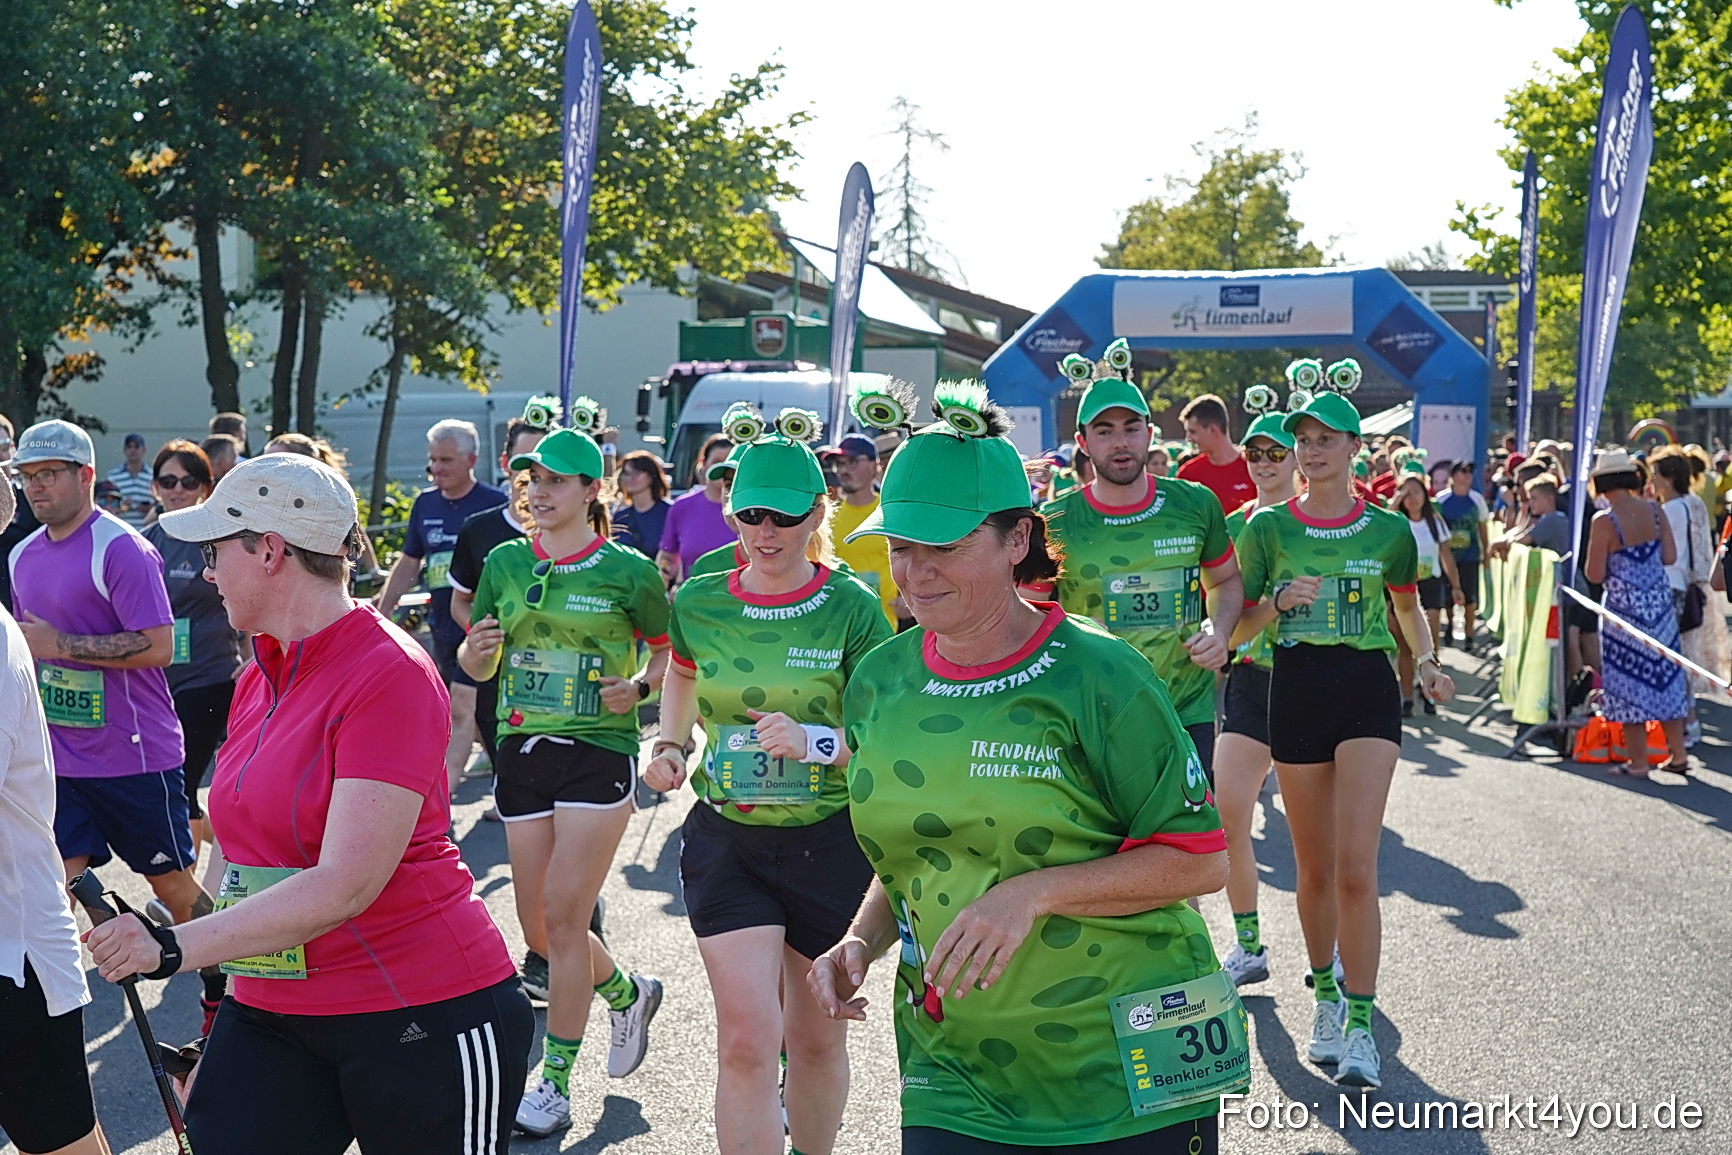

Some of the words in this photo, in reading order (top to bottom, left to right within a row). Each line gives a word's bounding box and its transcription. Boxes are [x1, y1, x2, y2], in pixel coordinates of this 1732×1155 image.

[29, 440, 57, 448] GOING
[1132, 592, 1160, 613] 33
[1327, 601, 1336, 629] 2022
[524, 670, 550, 692] 37
[563, 677, 574, 706] 2022
[45, 686, 91, 709] 1885
[92, 693, 100, 720] 2022
[970, 740, 1063, 764] TRENDHAUS
[723, 761, 732, 789] RUN
[752, 751, 785, 778] 31
[969, 763, 1065, 780] POWER-TEAM
[731, 780, 763, 789] Daume
[765, 780, 810, 789] Dominika
[810, 765, 819, 793] 202
[1157, 999, 1206, 1021] Firmenlauf
[1178, 1008, 1207, 1021] neumarkt
[400, 1031, 429, 1043] adidas
[1176, 1017, 1228, 1064] 30
[1130, 1048, 1151, 1090] RUN
[1153, 1067, 1211, 1088] Benkler
